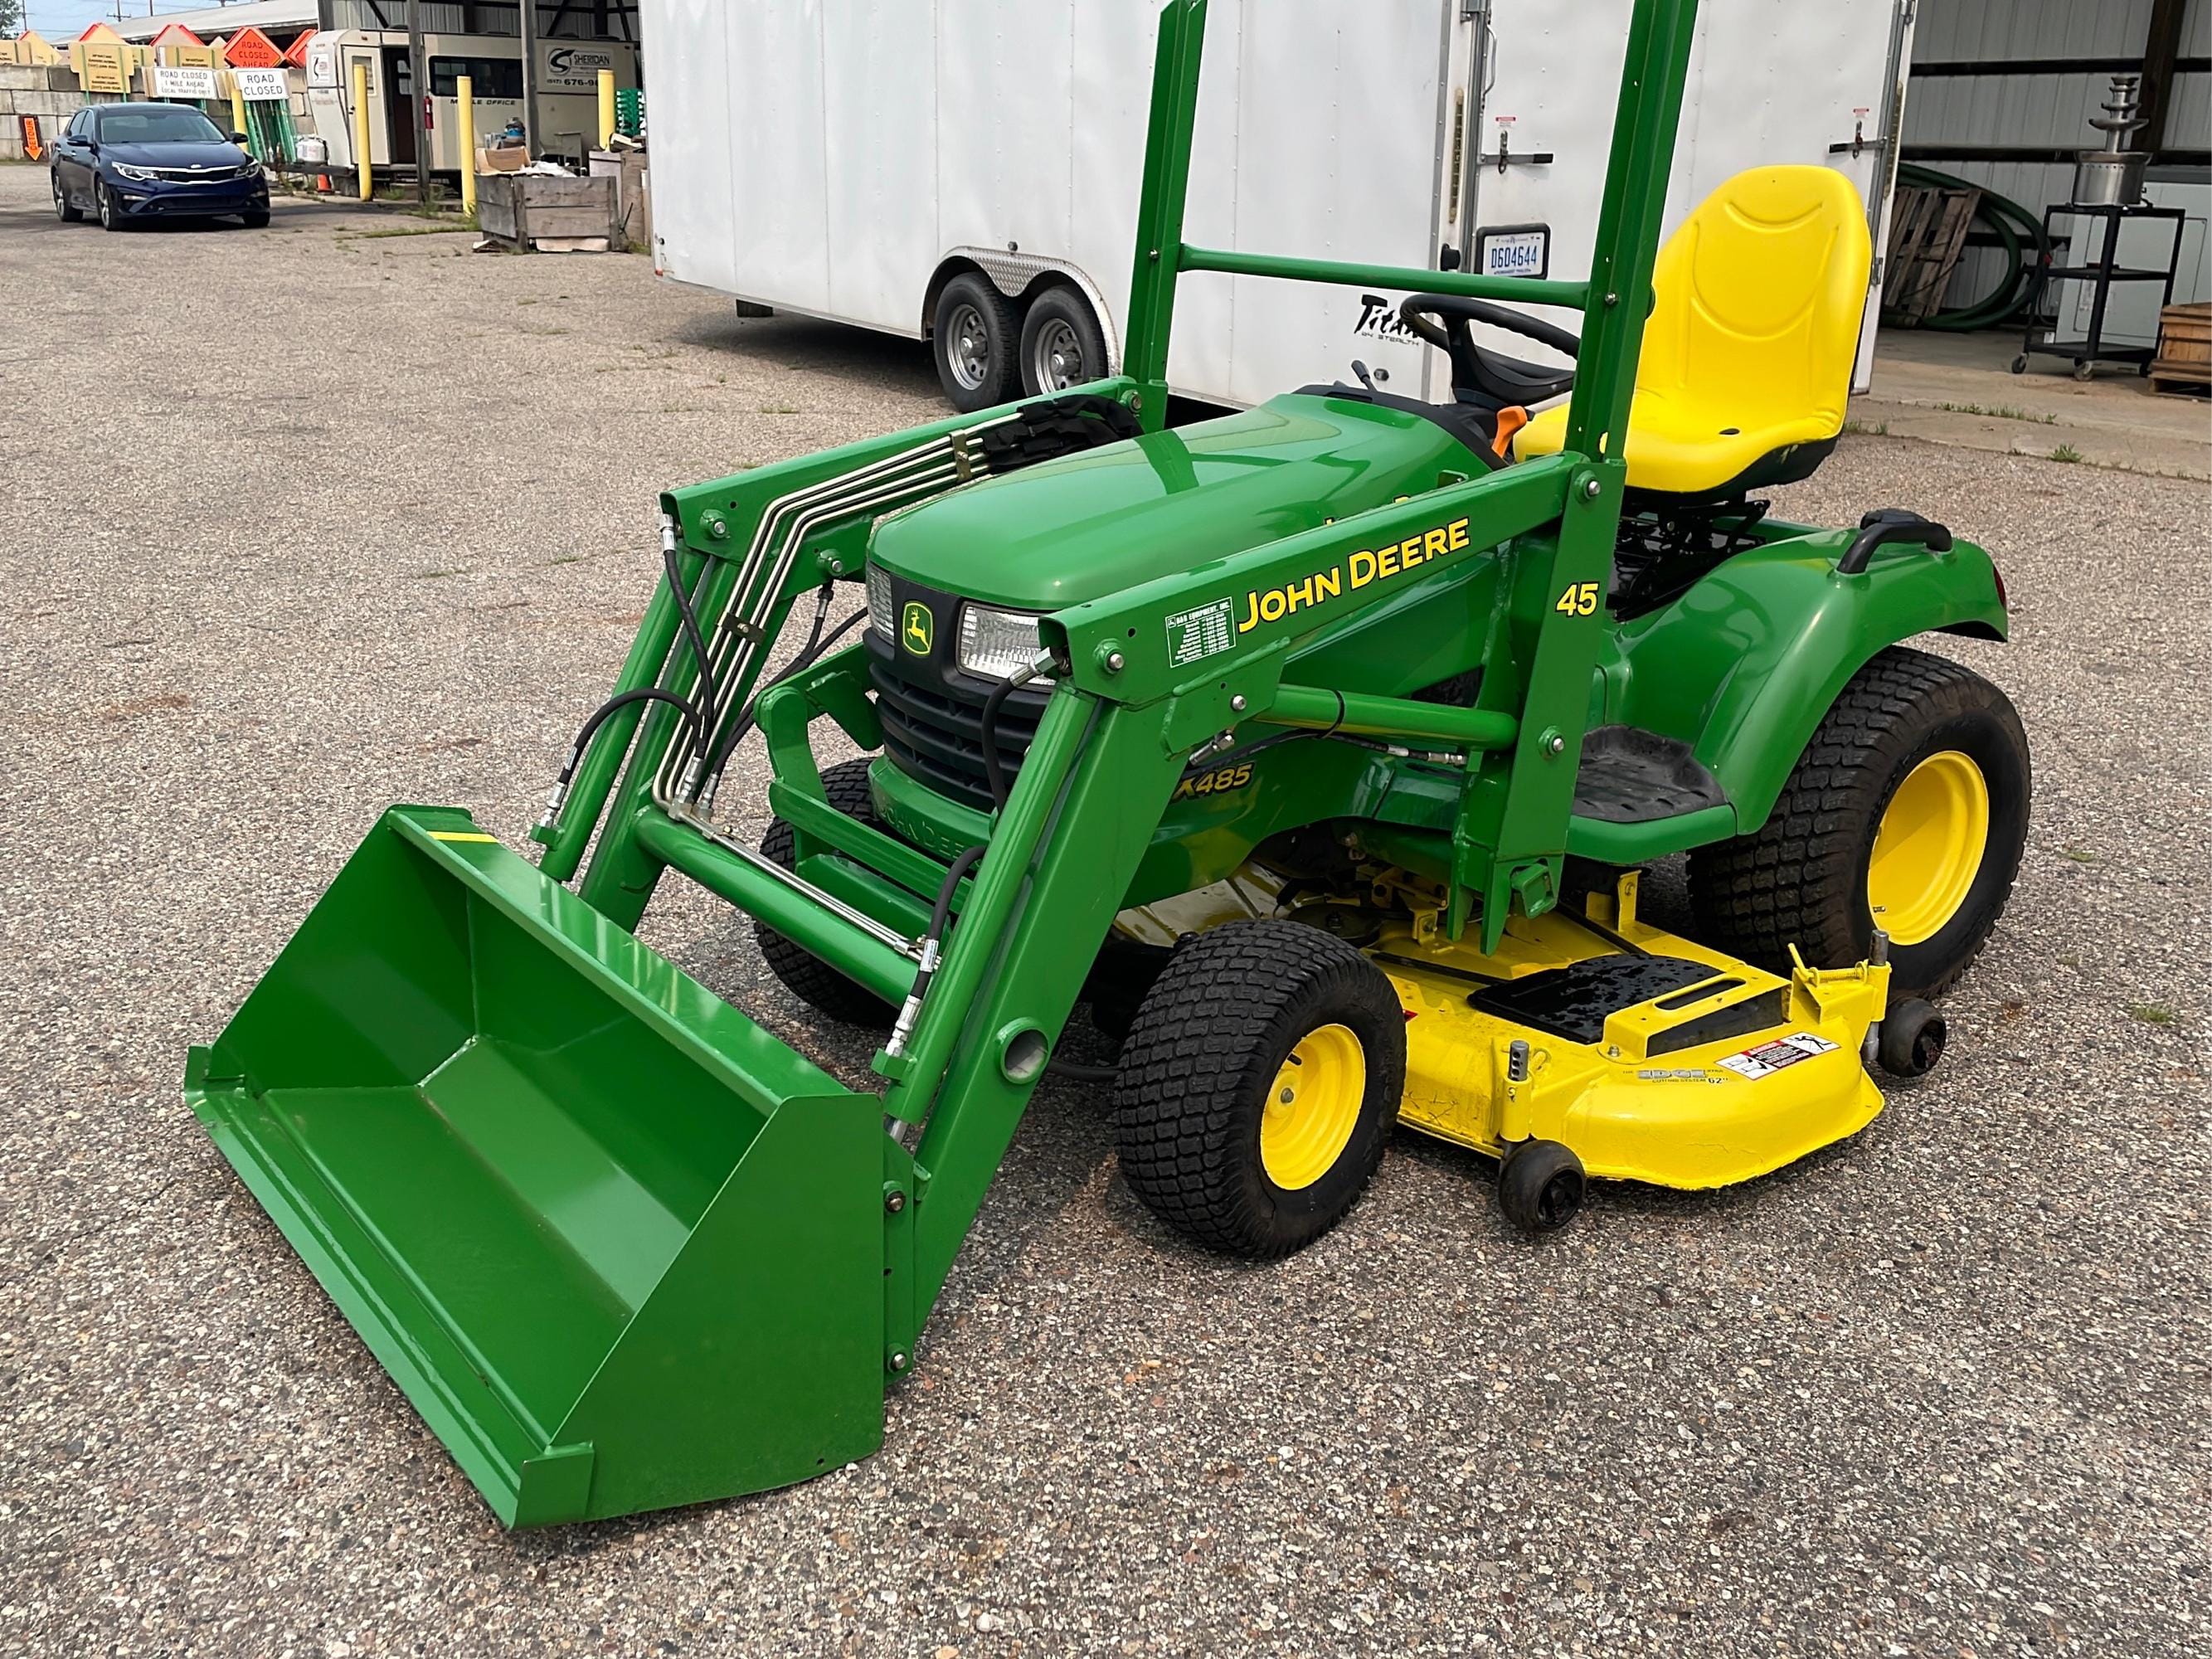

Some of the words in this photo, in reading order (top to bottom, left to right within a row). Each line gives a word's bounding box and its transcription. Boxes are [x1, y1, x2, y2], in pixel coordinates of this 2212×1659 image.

[238, 51, 269, 59] CLOSED
[573, 54, 610, 66] SHERIDAN
[181, 71, 207, 80] CLOSED
[246, 74, 275, 84] ROAD
[244, 85, 283, 95] CLOSED
[26, 119, 37, 150] DETOUR
[1490, 245, 1537, 269] D604644
[1378, 333, 1419, 346] STEALTH
[1237, 567, 1342, 634] JOHN
[1348, 517, 1471, 591] DEERE
[1555, 582, 1599, 616] 45
